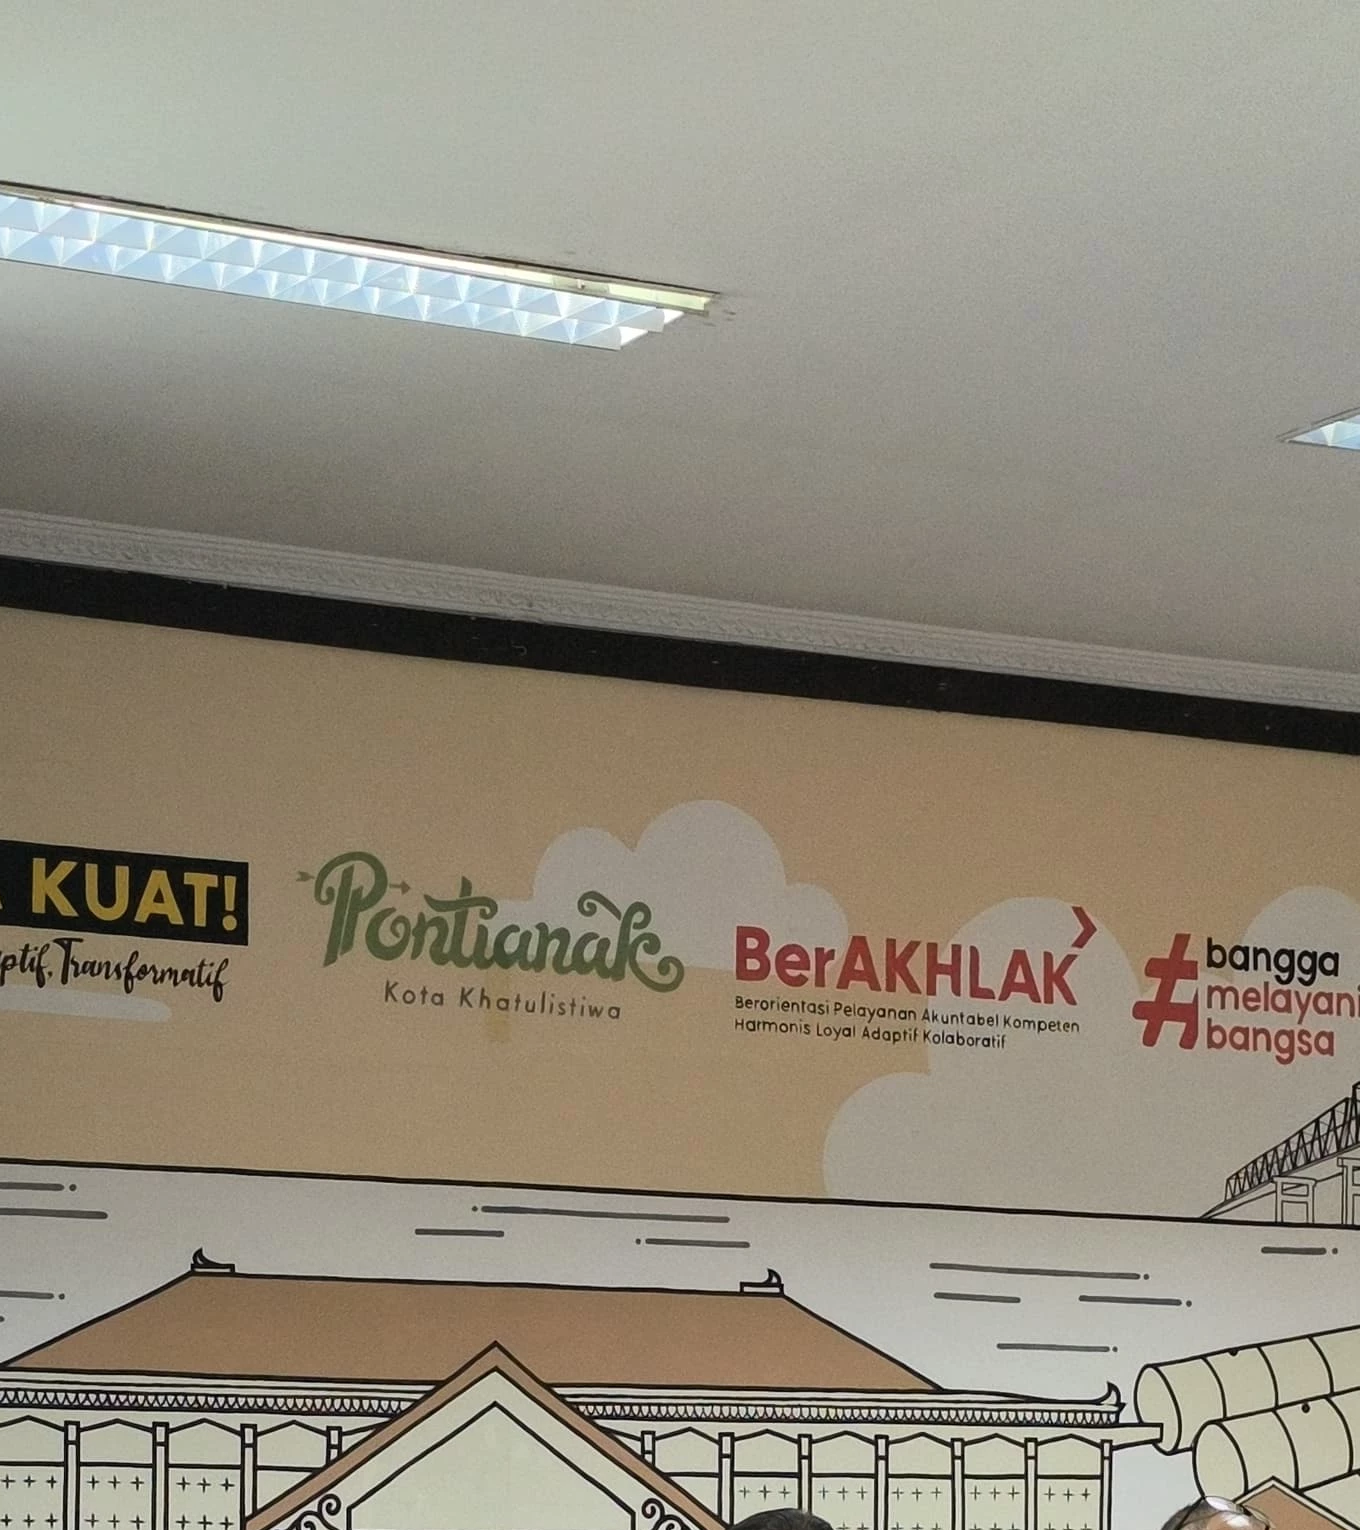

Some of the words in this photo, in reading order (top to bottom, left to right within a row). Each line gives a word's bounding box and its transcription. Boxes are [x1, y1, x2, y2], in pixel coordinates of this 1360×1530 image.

[31, 857, 239, 932] KUAT!
[314, 851, 685, 993] Pontianak
[53, 937, 231, 1002] Transformatif
[735, 925, 1078, 1006] BerAKHLAK
[1206, 937, 1339, 986] bangga
[384, 980, 444, 1008] Kota
[460, 986, 621, 1020] Khatulistiwa
[735, 996, 830, 1017] Berorientasi
[834, 1001, 917, 1023] Pelayanan
[922, 1007, 999, 1028] Akuntabel
[1003, 1016, 1080, 1034] Kompeten
[735, 1018, 811, 1036] Harmonis
[817, 1022, 856, 1041] Loyal
[862, 1026, 918, 1045] Adaptif
[924, 1029, 1006, 1049] Kolaboratif
[1206, 1018, 1335, 1065] bangsa
